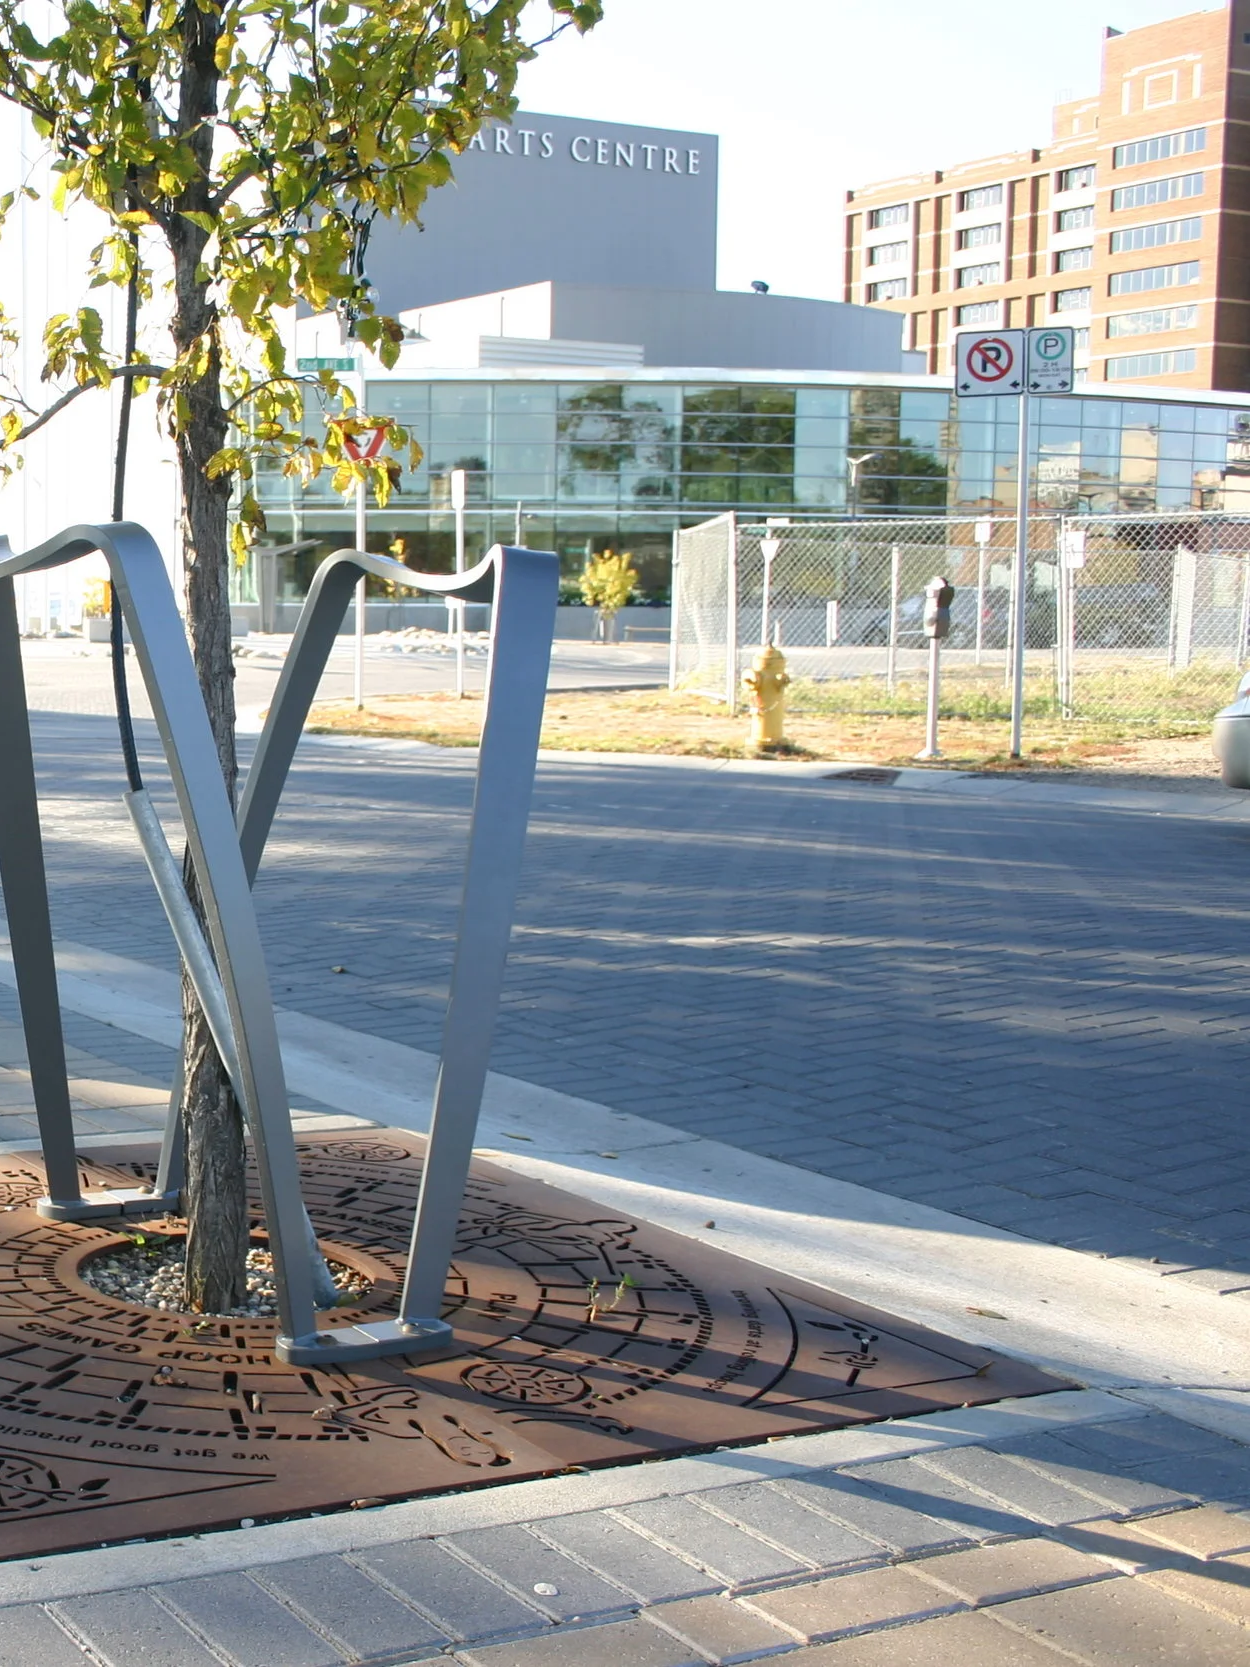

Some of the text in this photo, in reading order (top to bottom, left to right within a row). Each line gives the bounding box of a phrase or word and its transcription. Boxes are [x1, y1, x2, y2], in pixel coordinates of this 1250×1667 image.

[468, 127, 700, 176] ARTS CENTRE
[307, 1208, 412, 1232] GAMES
[477, 1293, 517, 1322] PLAY
[18, 1321, 271, 1366] HOOP GAMES
[89, 1439, 160, 1453] good
[173, 1447, 218, 1458] get
[232, 1452, 270, 1461] we
